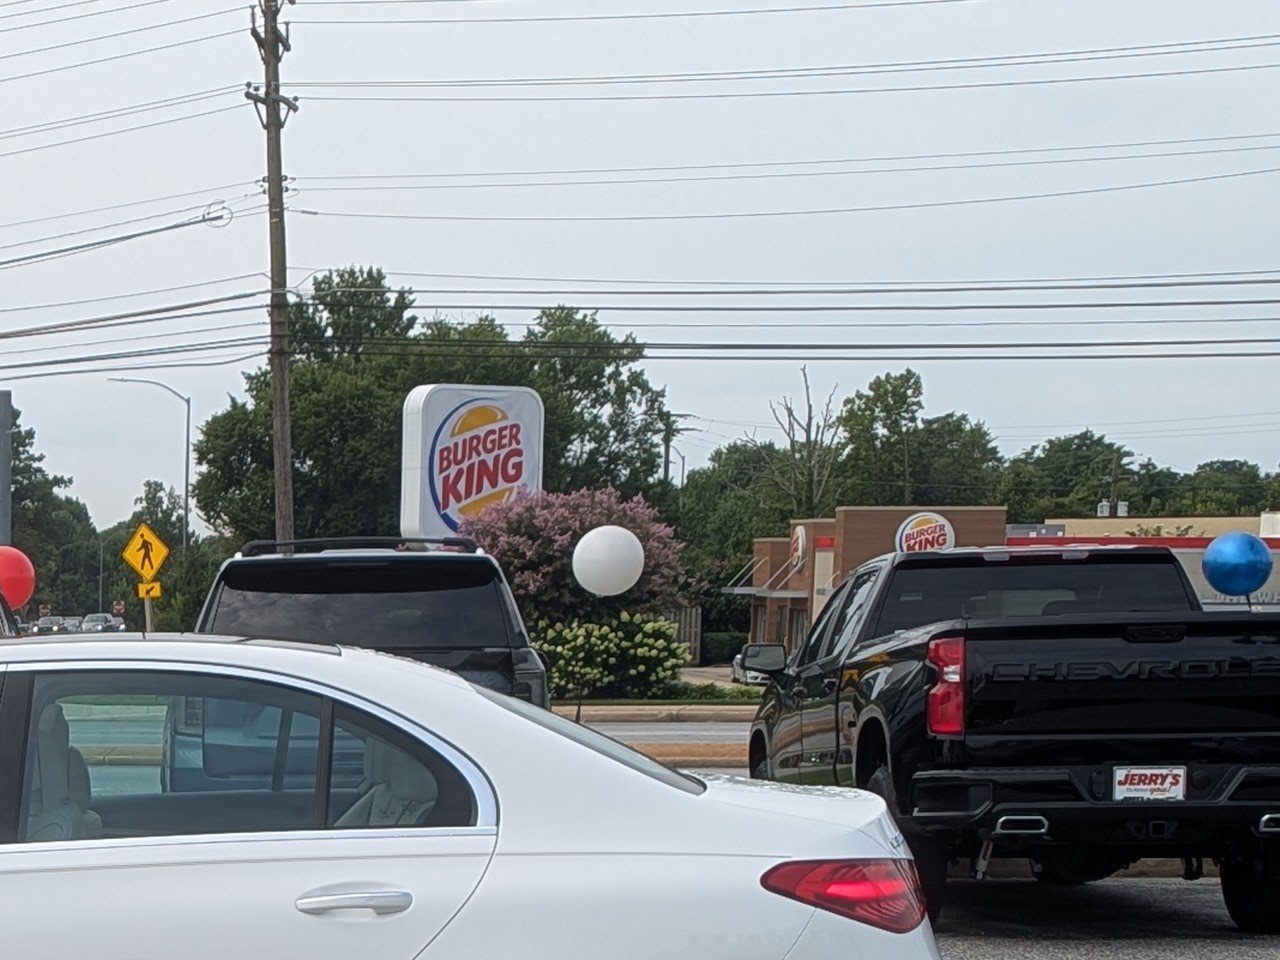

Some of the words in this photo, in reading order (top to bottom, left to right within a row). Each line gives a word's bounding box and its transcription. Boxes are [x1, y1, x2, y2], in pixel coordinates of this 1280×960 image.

[439, 423, 521, 475] BURGER
[442, 447, 524, 511] KING
[905, 523, 946, 543] BURGER
[907, 533, 948, 551] KING
[1118, 773, 1182, 787] JERRY'S
